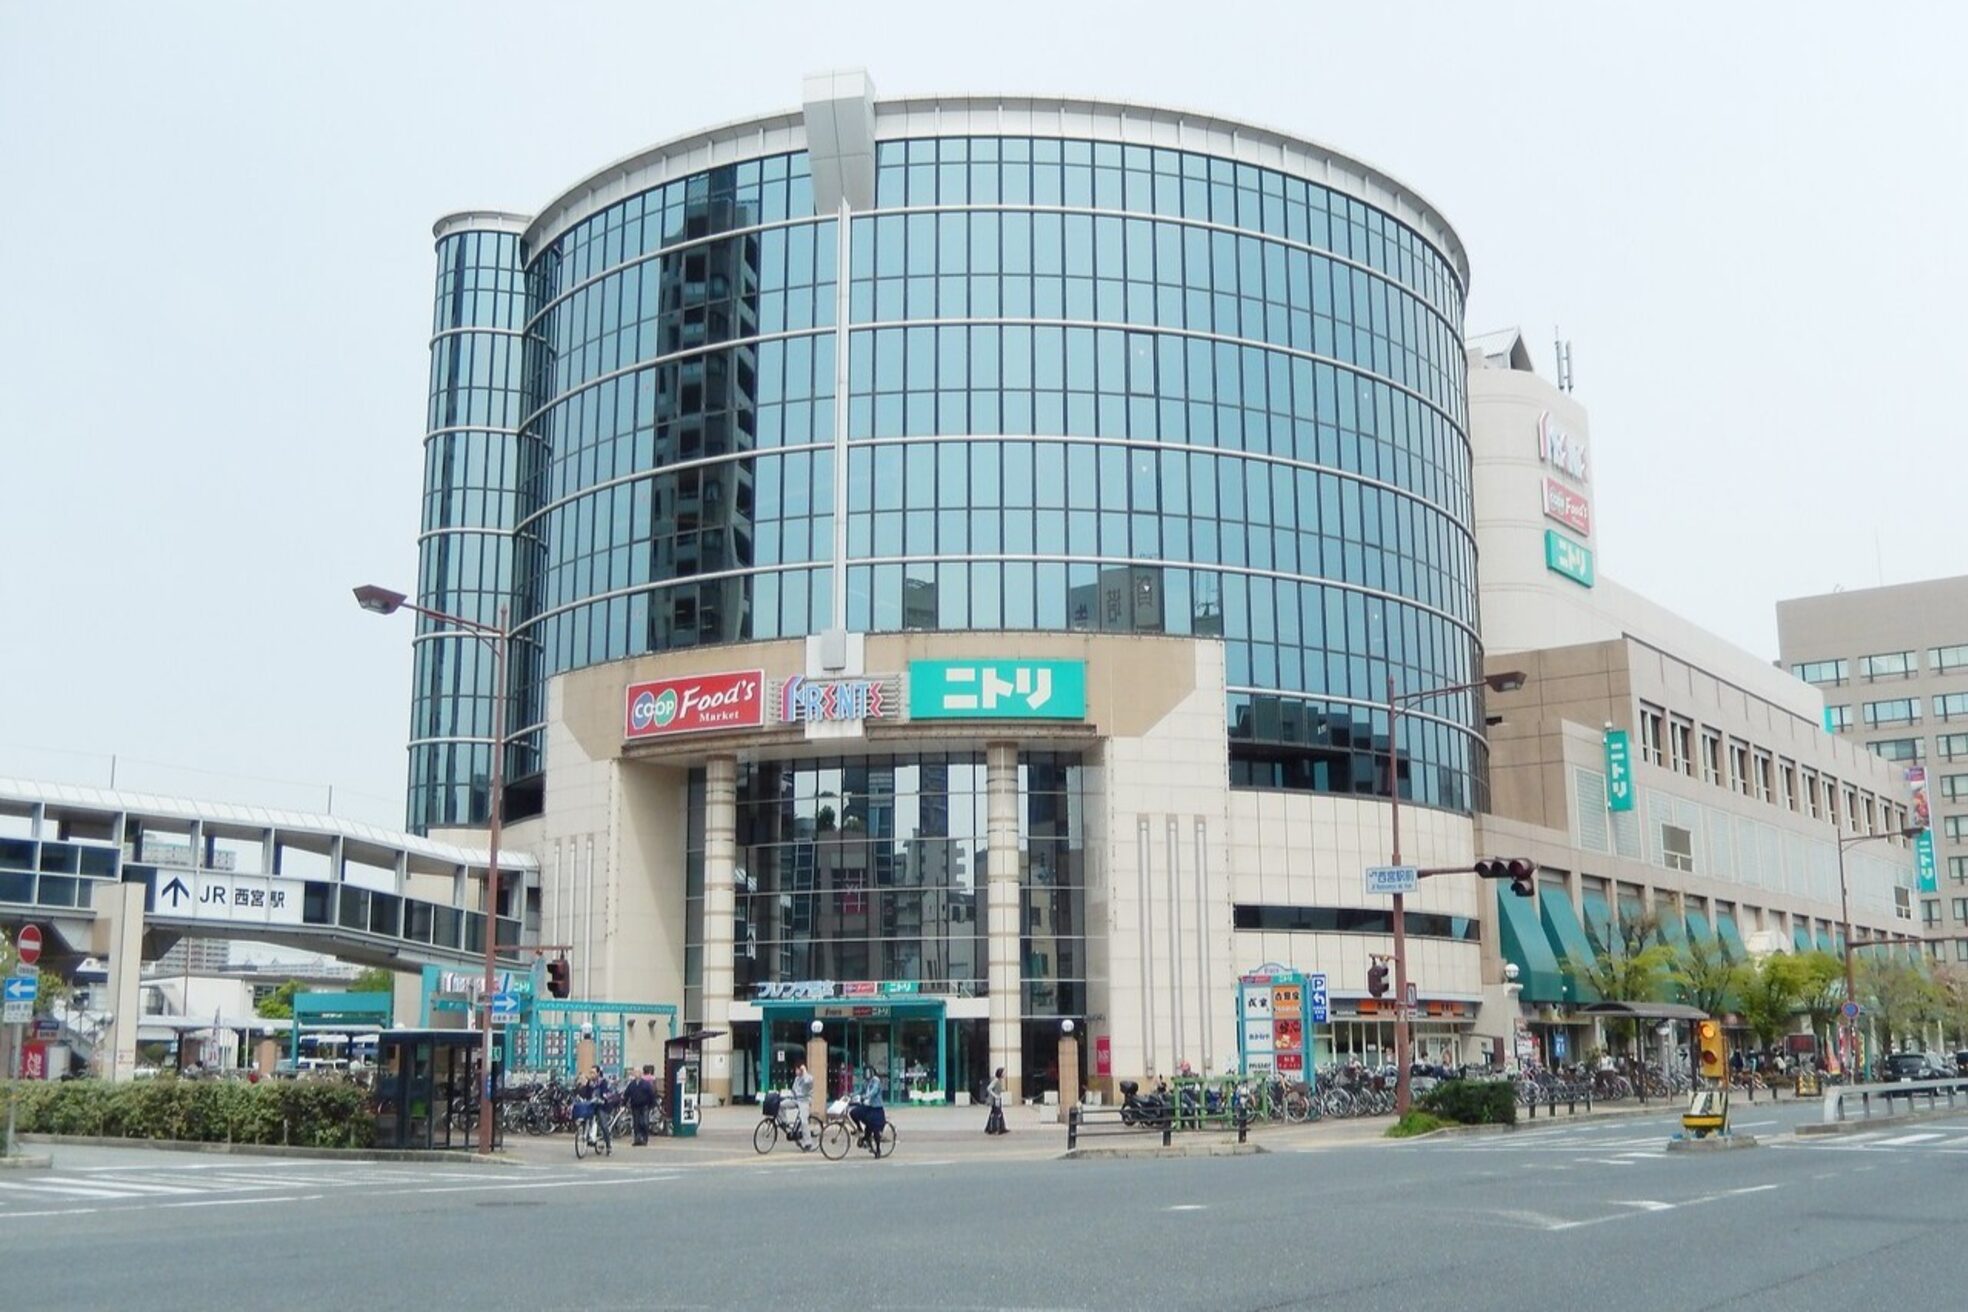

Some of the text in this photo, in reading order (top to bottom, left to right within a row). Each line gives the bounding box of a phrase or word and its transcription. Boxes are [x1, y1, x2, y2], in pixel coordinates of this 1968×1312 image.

[1558, 539, 1586, 576] ニトリ
[634, 680, 757, 720] COOP Food's
[781, 675, 884, 722] FRENTE
[943, 667, 1052, 711] ニトリ
[699, 711, 740, 723] Market
[1610, 742, 1627, 798] ニトリ
[1919, 840, 1934, 880] ニトリ
[199, 885, 285, 908] JR 西宮駅
[888, 981, 912, 993] ニトリ
[1314, 979, 1324, 990] P
